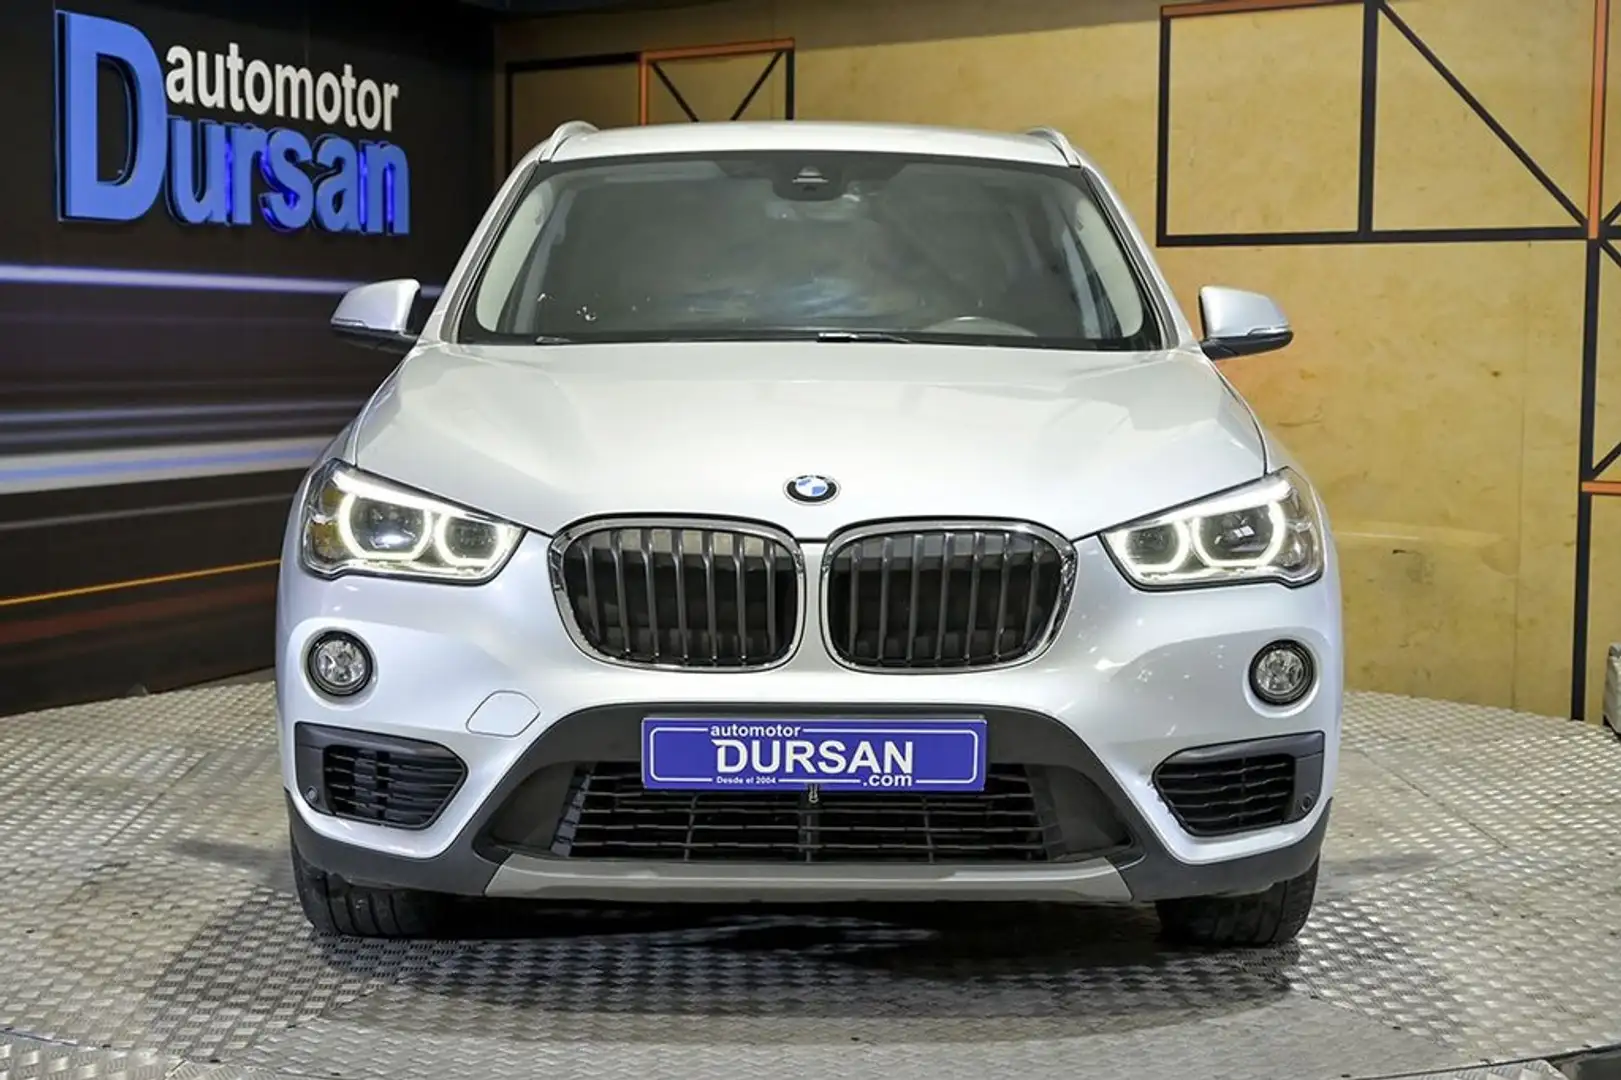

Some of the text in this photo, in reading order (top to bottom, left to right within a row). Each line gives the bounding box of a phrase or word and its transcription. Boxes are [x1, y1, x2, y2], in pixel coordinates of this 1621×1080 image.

[166, 42, 399, 132] automotor
[56, 10, 410, 235] Dursan
[710, 723, 801, 737] automotor
[711, 739, 913, 774] DURSAN
[716, 776, 743, 784] Desde
[745, 776, 754, 784] el
[863, 774, 912, 787] .com
